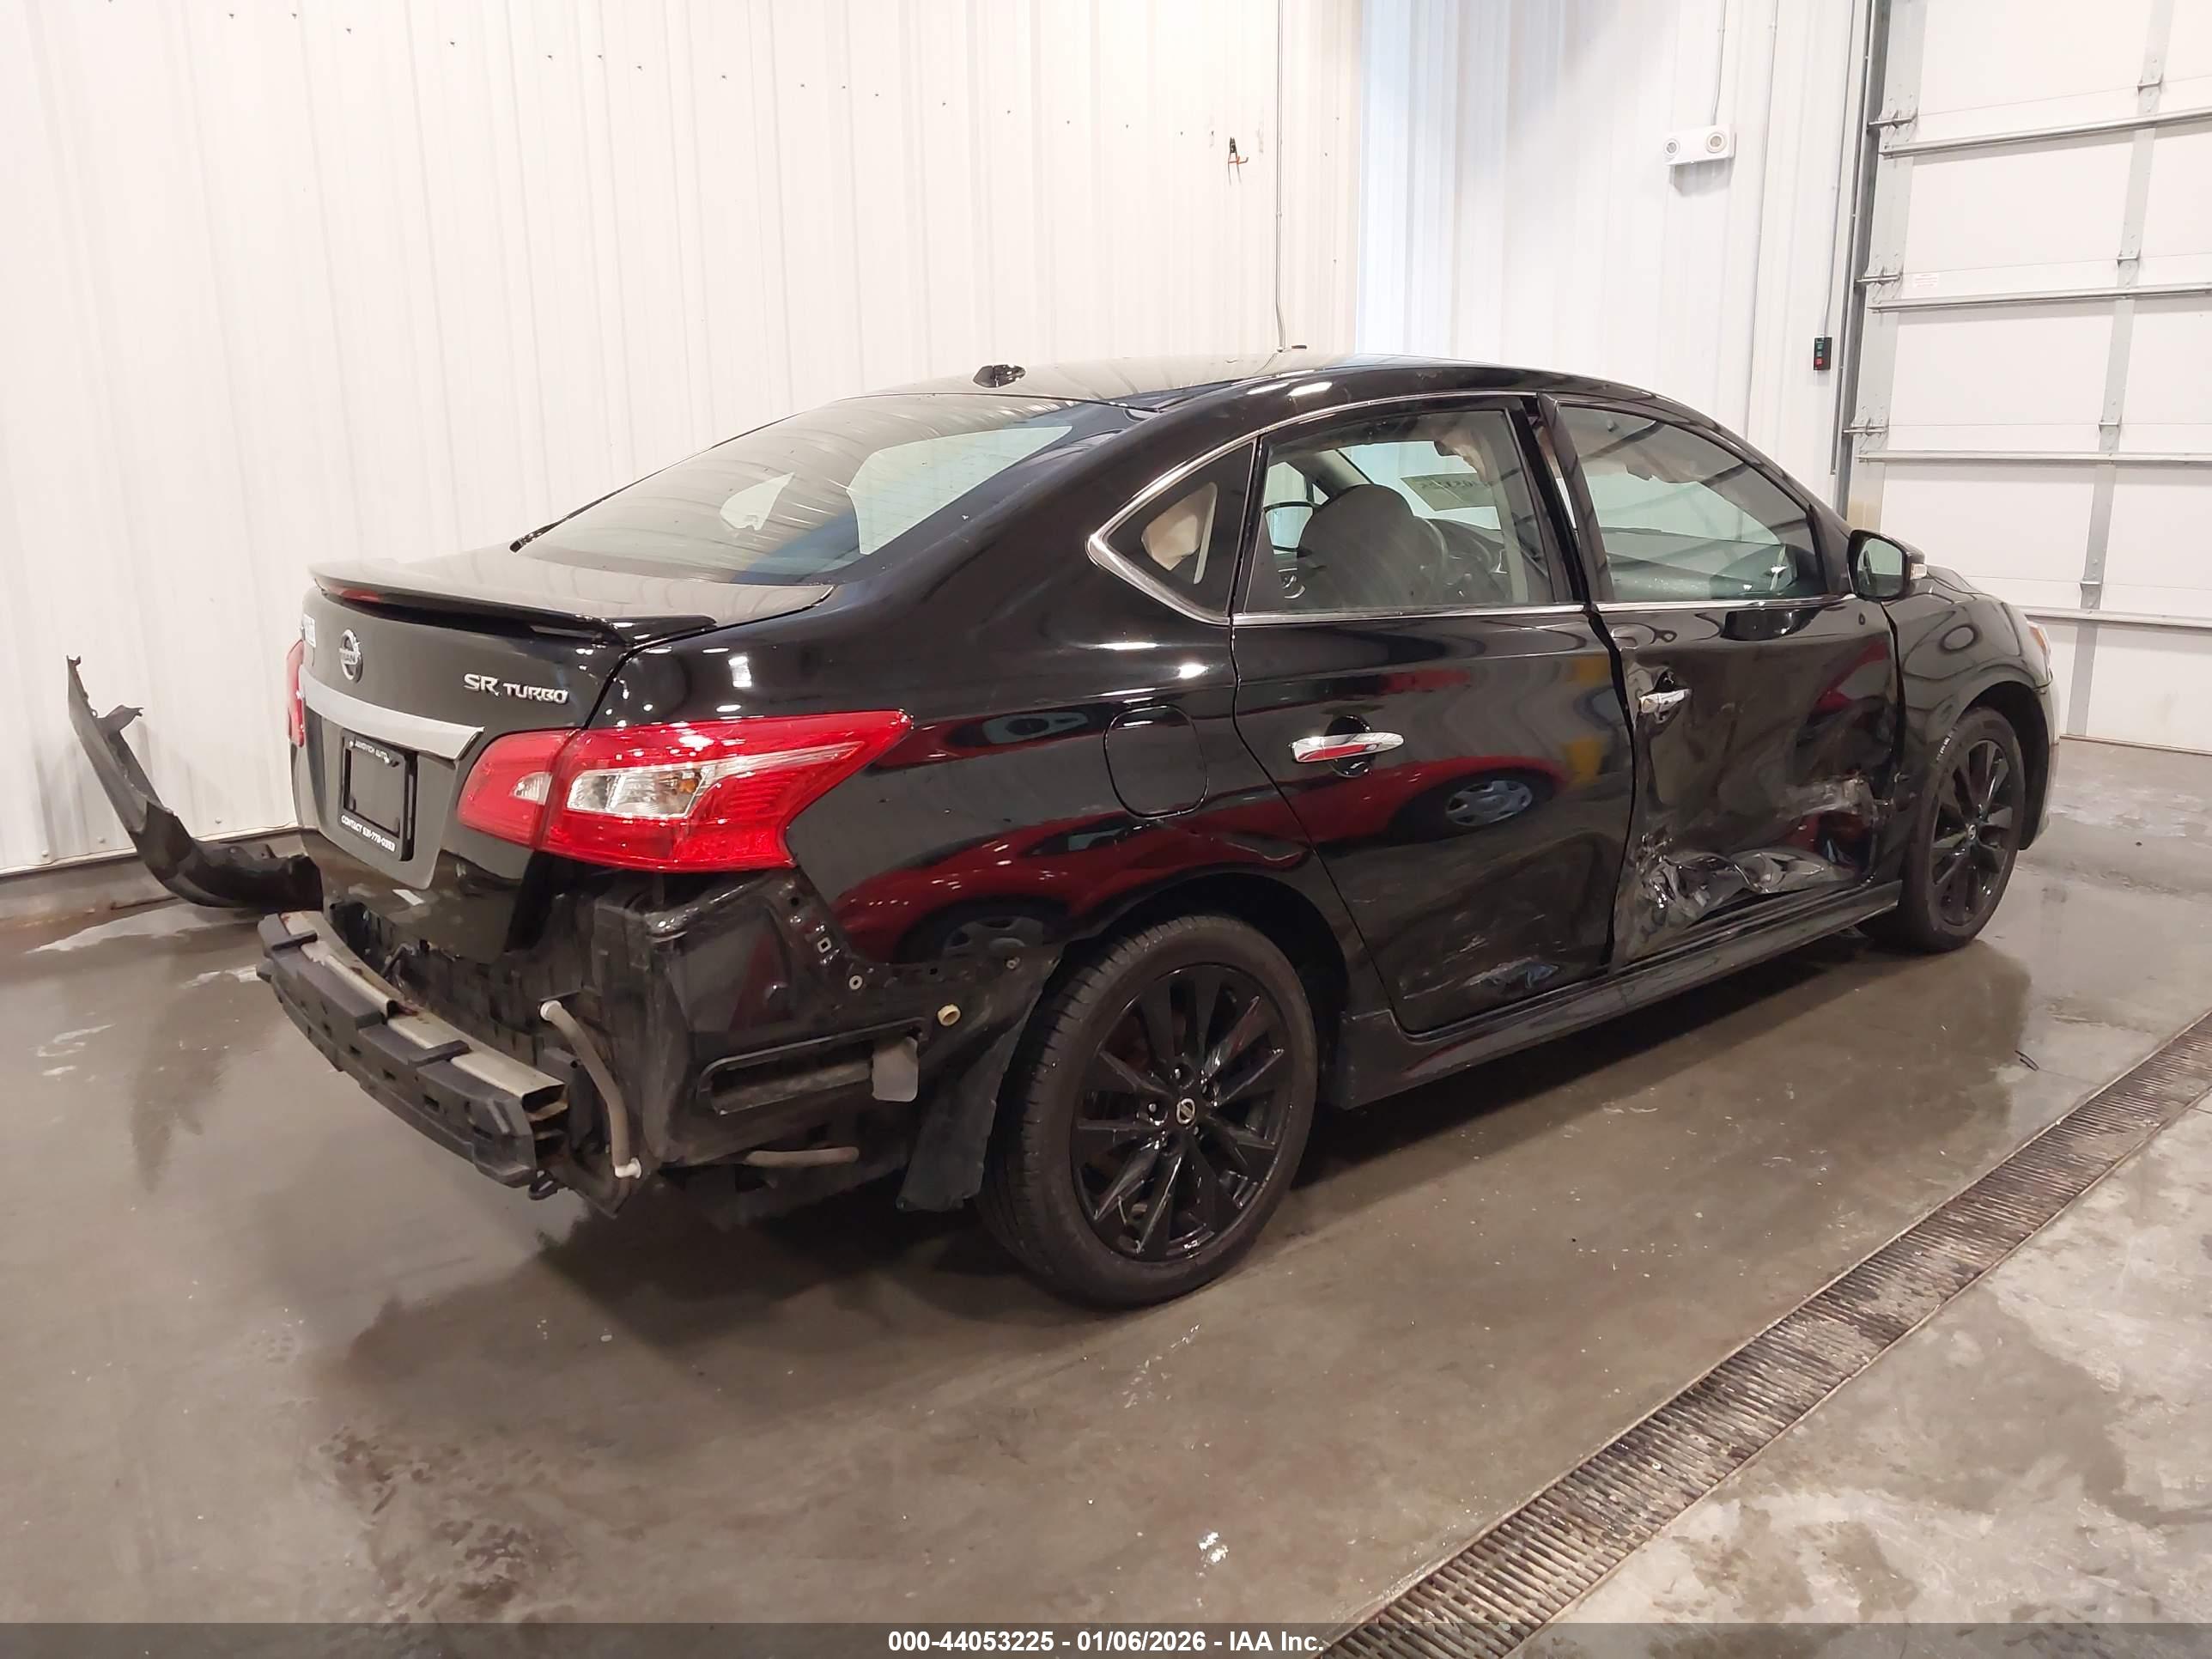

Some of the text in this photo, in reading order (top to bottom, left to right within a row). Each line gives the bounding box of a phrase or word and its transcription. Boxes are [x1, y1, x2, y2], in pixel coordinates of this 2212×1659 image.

[464, 673, 568, 704] SR TURBO
[341, 814, 363, 833] CONTACT
